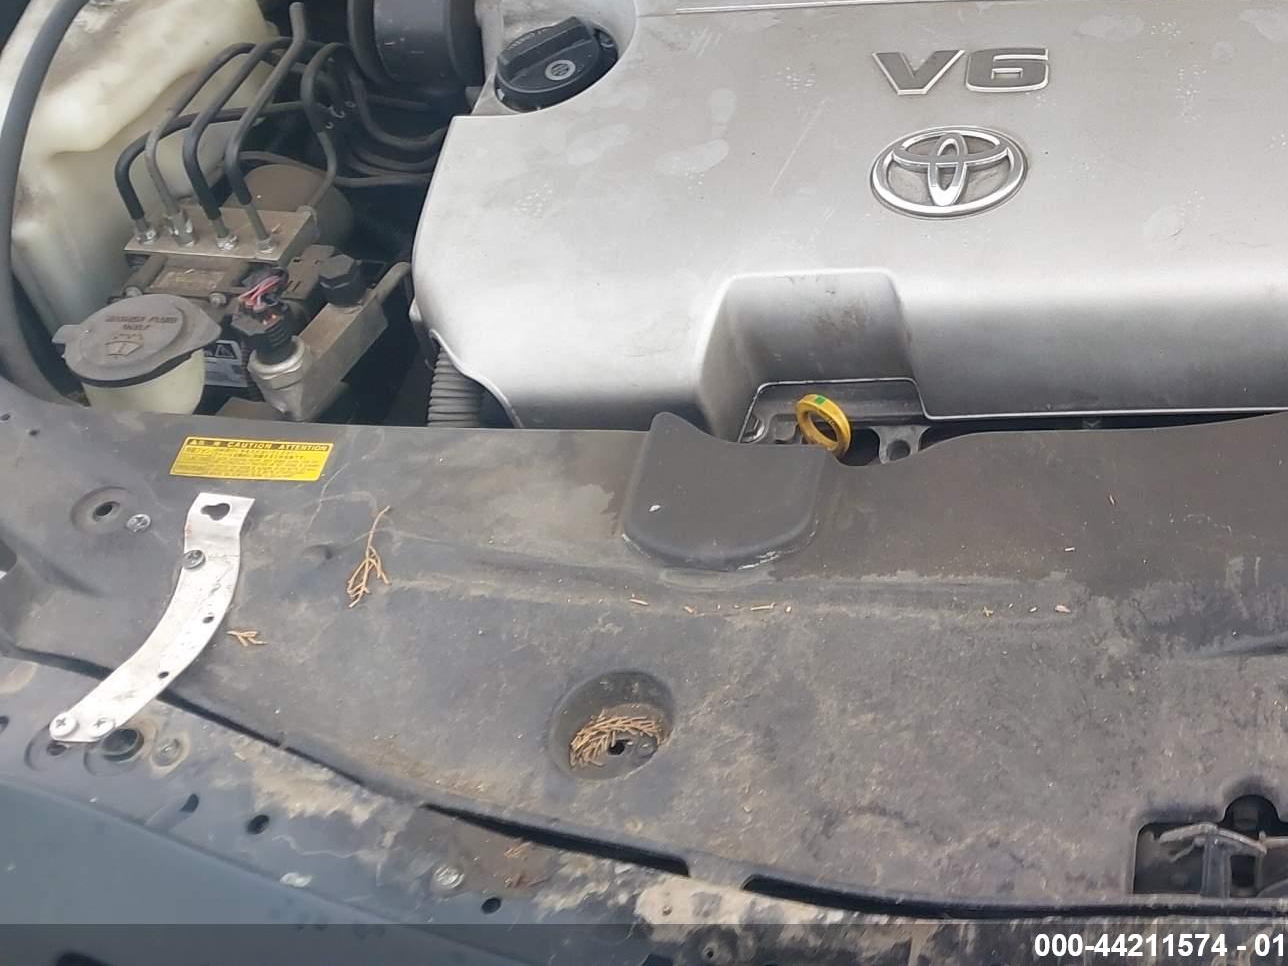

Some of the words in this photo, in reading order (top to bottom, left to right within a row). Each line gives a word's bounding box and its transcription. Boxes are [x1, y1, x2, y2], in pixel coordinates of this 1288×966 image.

[872, 47, 1049, 96] V6
[227, 441, 273, 450] CAUTION
[278, 443, 329, 452] ATTENTION
